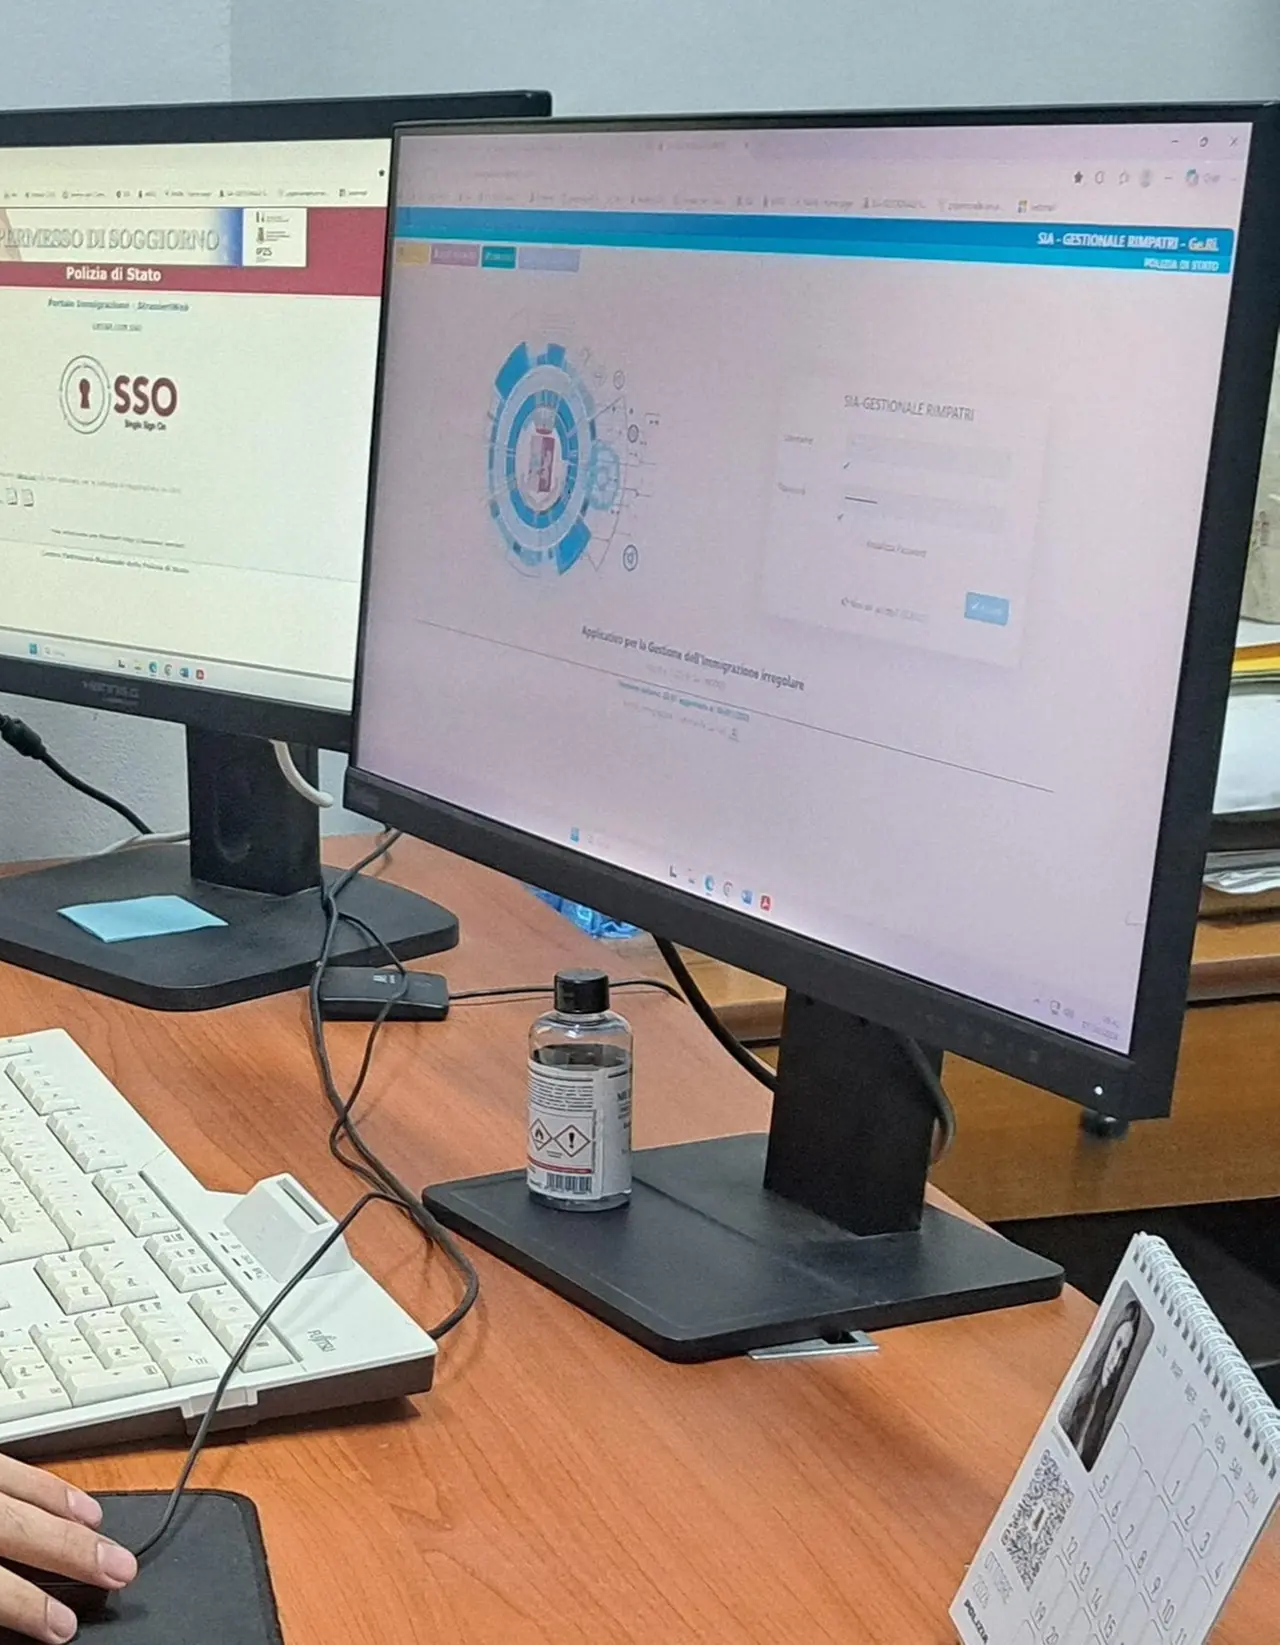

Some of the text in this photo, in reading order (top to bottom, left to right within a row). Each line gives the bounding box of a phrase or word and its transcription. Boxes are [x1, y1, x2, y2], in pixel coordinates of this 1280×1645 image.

[86, 229, 105, 250] DI
[107, 229, 220, 252] SOGGIORNO
[1063, 233, 1126, 249] GESTIONALE
[65, 266, 162, 284] Polizia di Stato
[113, 374, 178, 417] SSO
